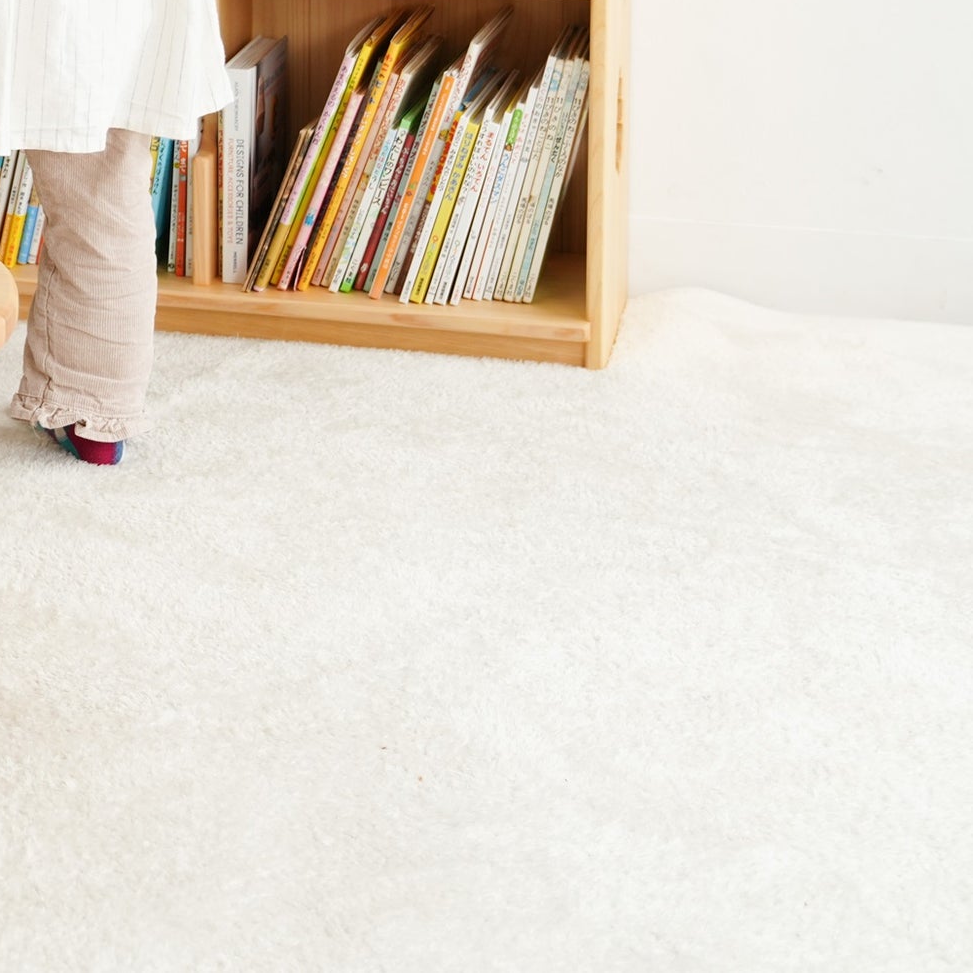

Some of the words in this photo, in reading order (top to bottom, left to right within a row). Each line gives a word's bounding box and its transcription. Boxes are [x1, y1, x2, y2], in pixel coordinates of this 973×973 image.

[235, 138, 244, 177] DESIGNS
[372, 134, 403, 206] わたしのワンピース
[235, 179, 244, 197] FOR
[235, 199, 244, 244] CHILDREN
